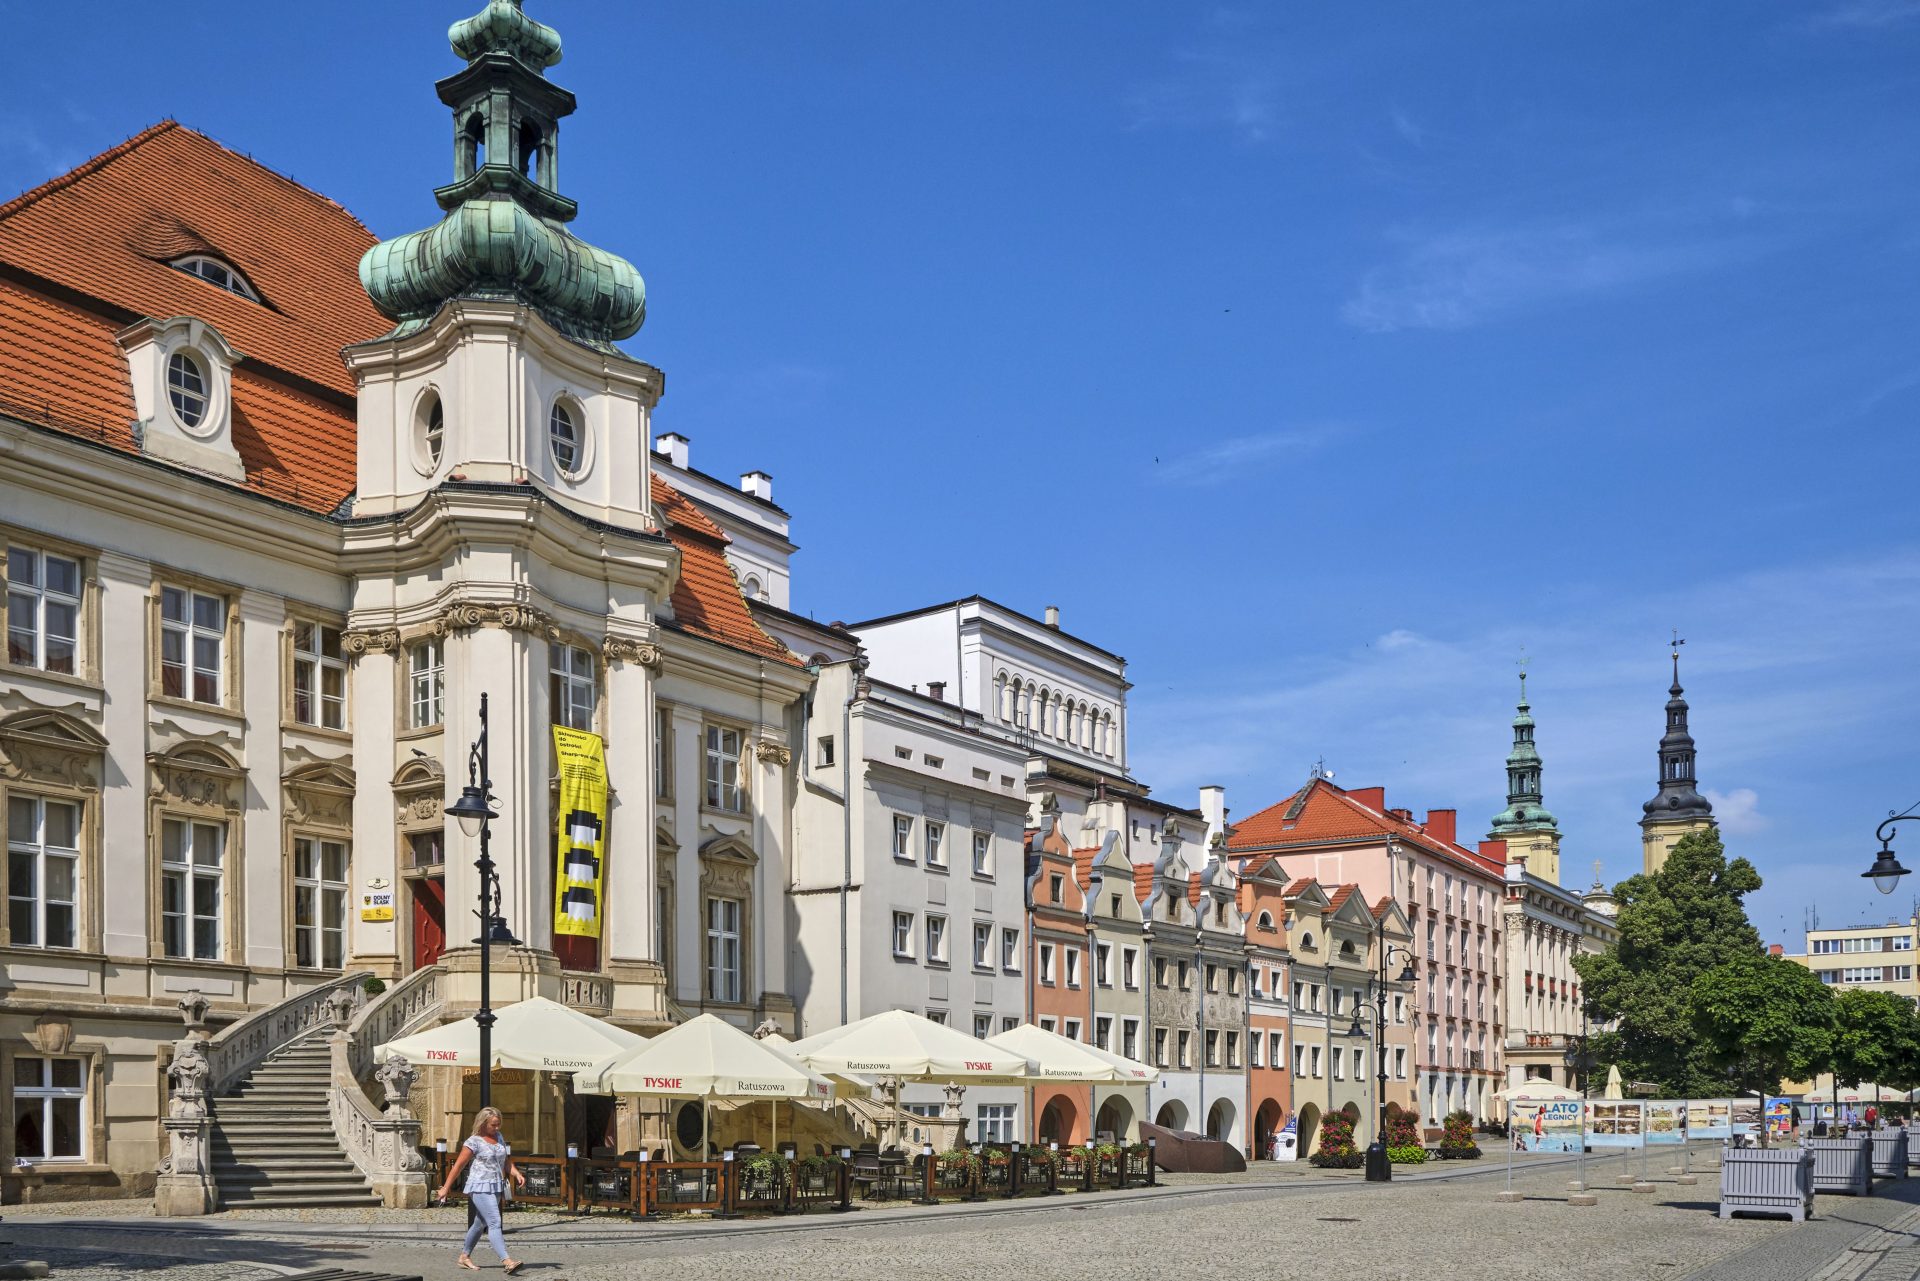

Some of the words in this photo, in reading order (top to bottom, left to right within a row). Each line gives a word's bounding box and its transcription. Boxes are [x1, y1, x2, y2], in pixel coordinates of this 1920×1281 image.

[426, 1050, 458, 1061] TYSKIE
[543, 1057, 593, 1068] Ratuszowa
[847, 1061, 891, 1070] Ratuszowa
[964, 1061, 993, 1071] TYSKIE
[1044, 1068, 1083, 1077] Ratuszowa
[643, 1077, 683, 1089] TYSKIE
[737, 1080, 785, 1091] Ratuszowa
[1544, 1104, 1578, 1113] LATO
